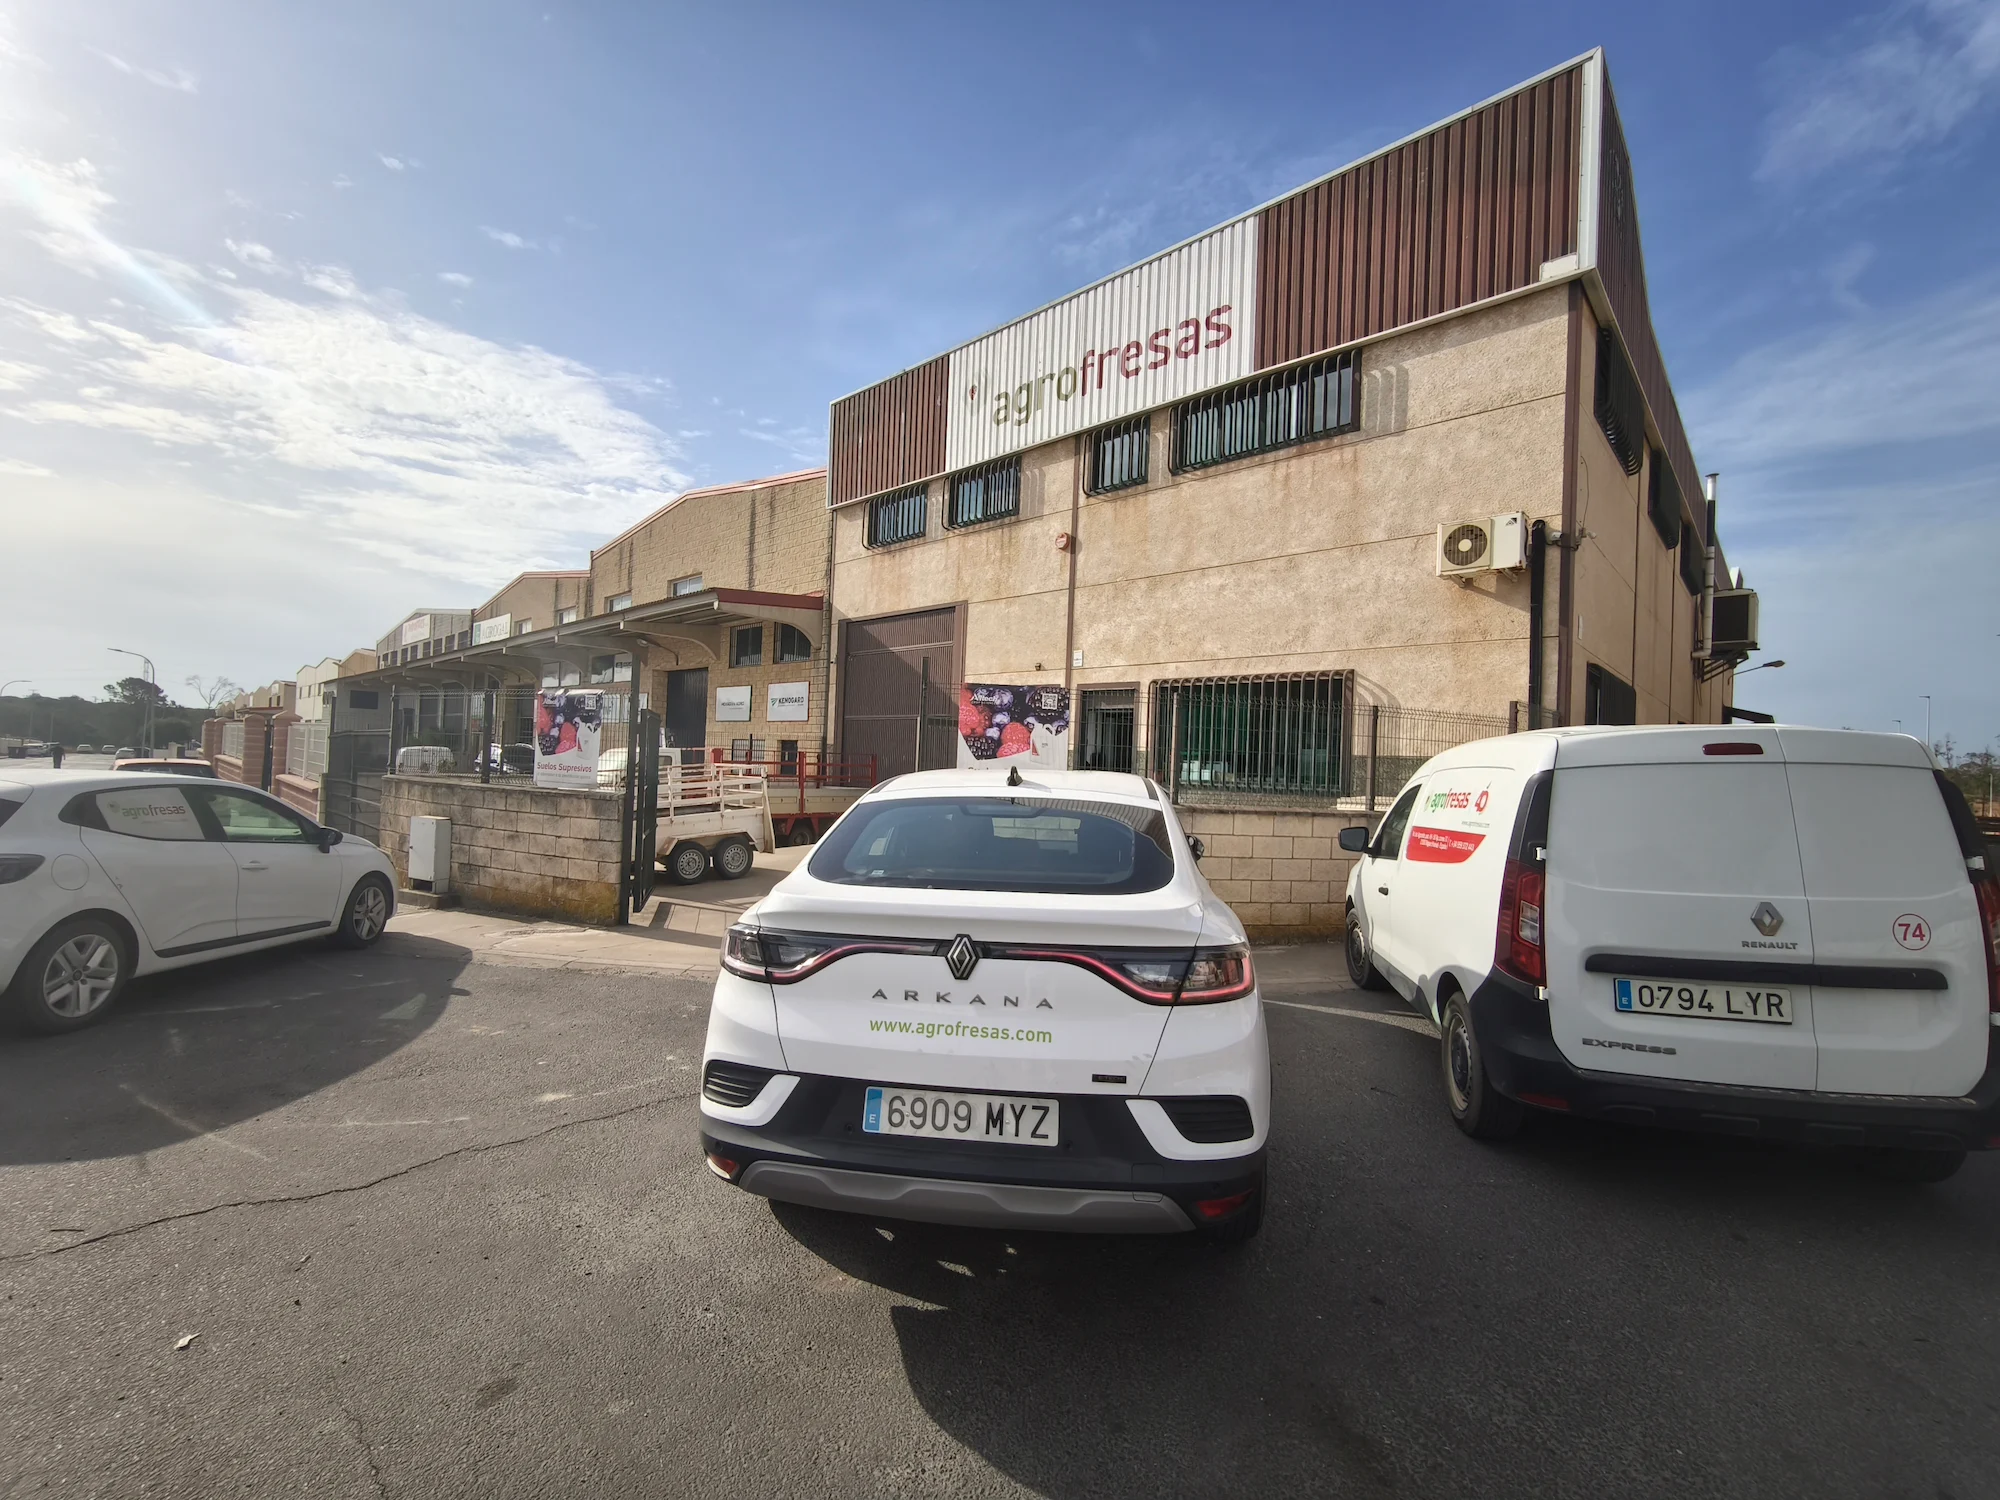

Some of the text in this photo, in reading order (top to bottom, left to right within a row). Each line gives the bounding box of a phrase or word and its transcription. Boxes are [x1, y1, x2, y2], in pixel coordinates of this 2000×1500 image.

[993, 304, 1232, 427] agrofresas
[969, 693, 998, 701] Alltech
[537, 762, 592, 773] Suelos Supresivos
[1430, 788, 1472, 813] agrofresas
[121, 804, 186, 819] agrofresas
[1898, 923, 1926, 942] 74
[1742, 940, 1798, 950] RENAULT
[872, 988, 1053, 1010] ARKANA
[1622, 985, 1784, 1017] E 0794 LYR
[869, 1019, 1053, 1043] www.agrofresas.com
[1582, 1038, 1677, 1055] EXPRESS
[868, 1095, 1050, 1140] E 6909 MYZ
